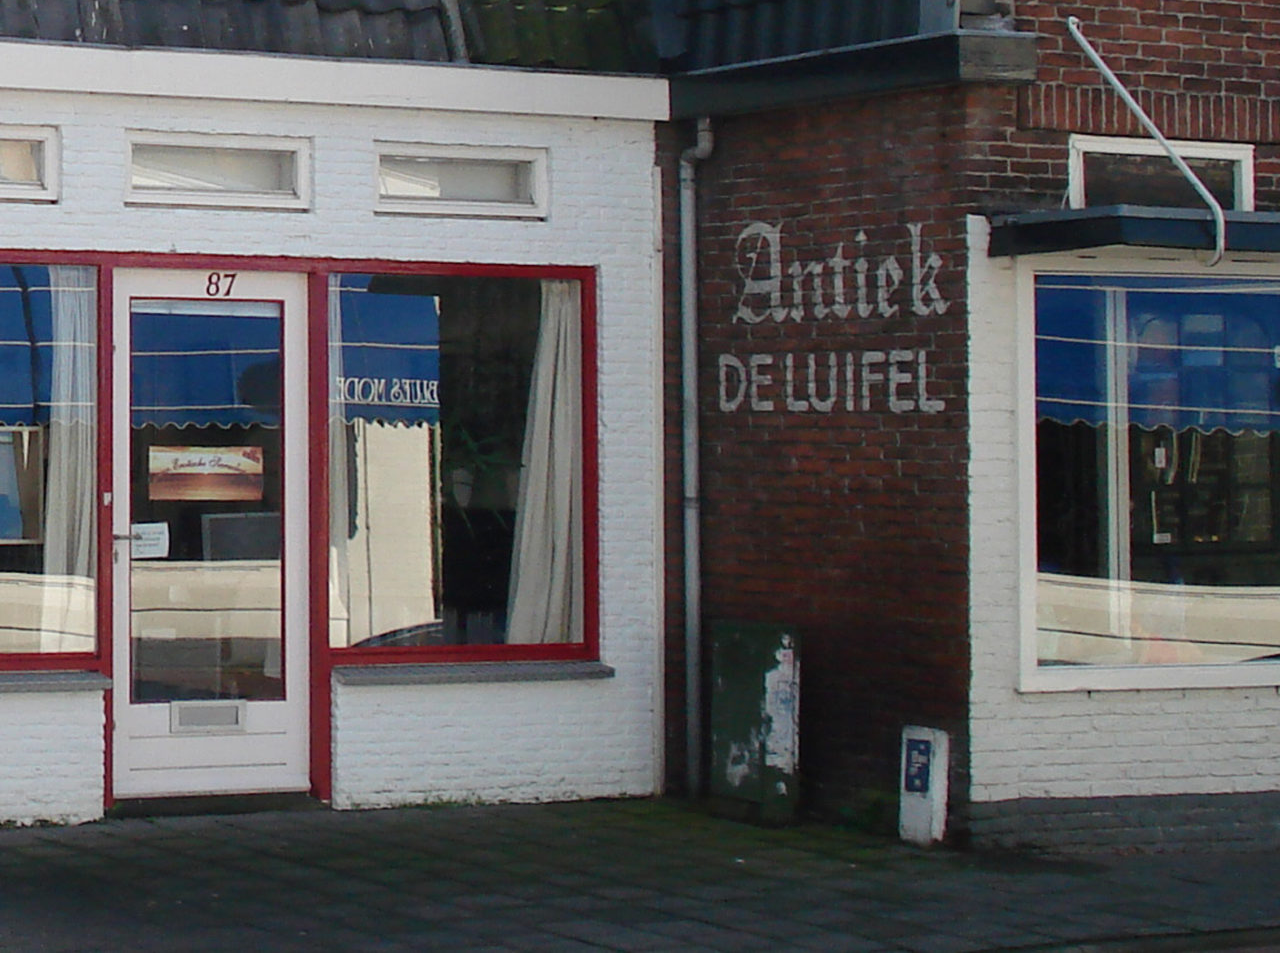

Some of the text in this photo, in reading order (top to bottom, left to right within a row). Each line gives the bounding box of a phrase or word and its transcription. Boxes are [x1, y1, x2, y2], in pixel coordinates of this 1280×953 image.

[206, 271, 238, 297] 87
[732, 222, 950, 324] Antiek
[718, 349, 946, 414] DE LUIFEL
